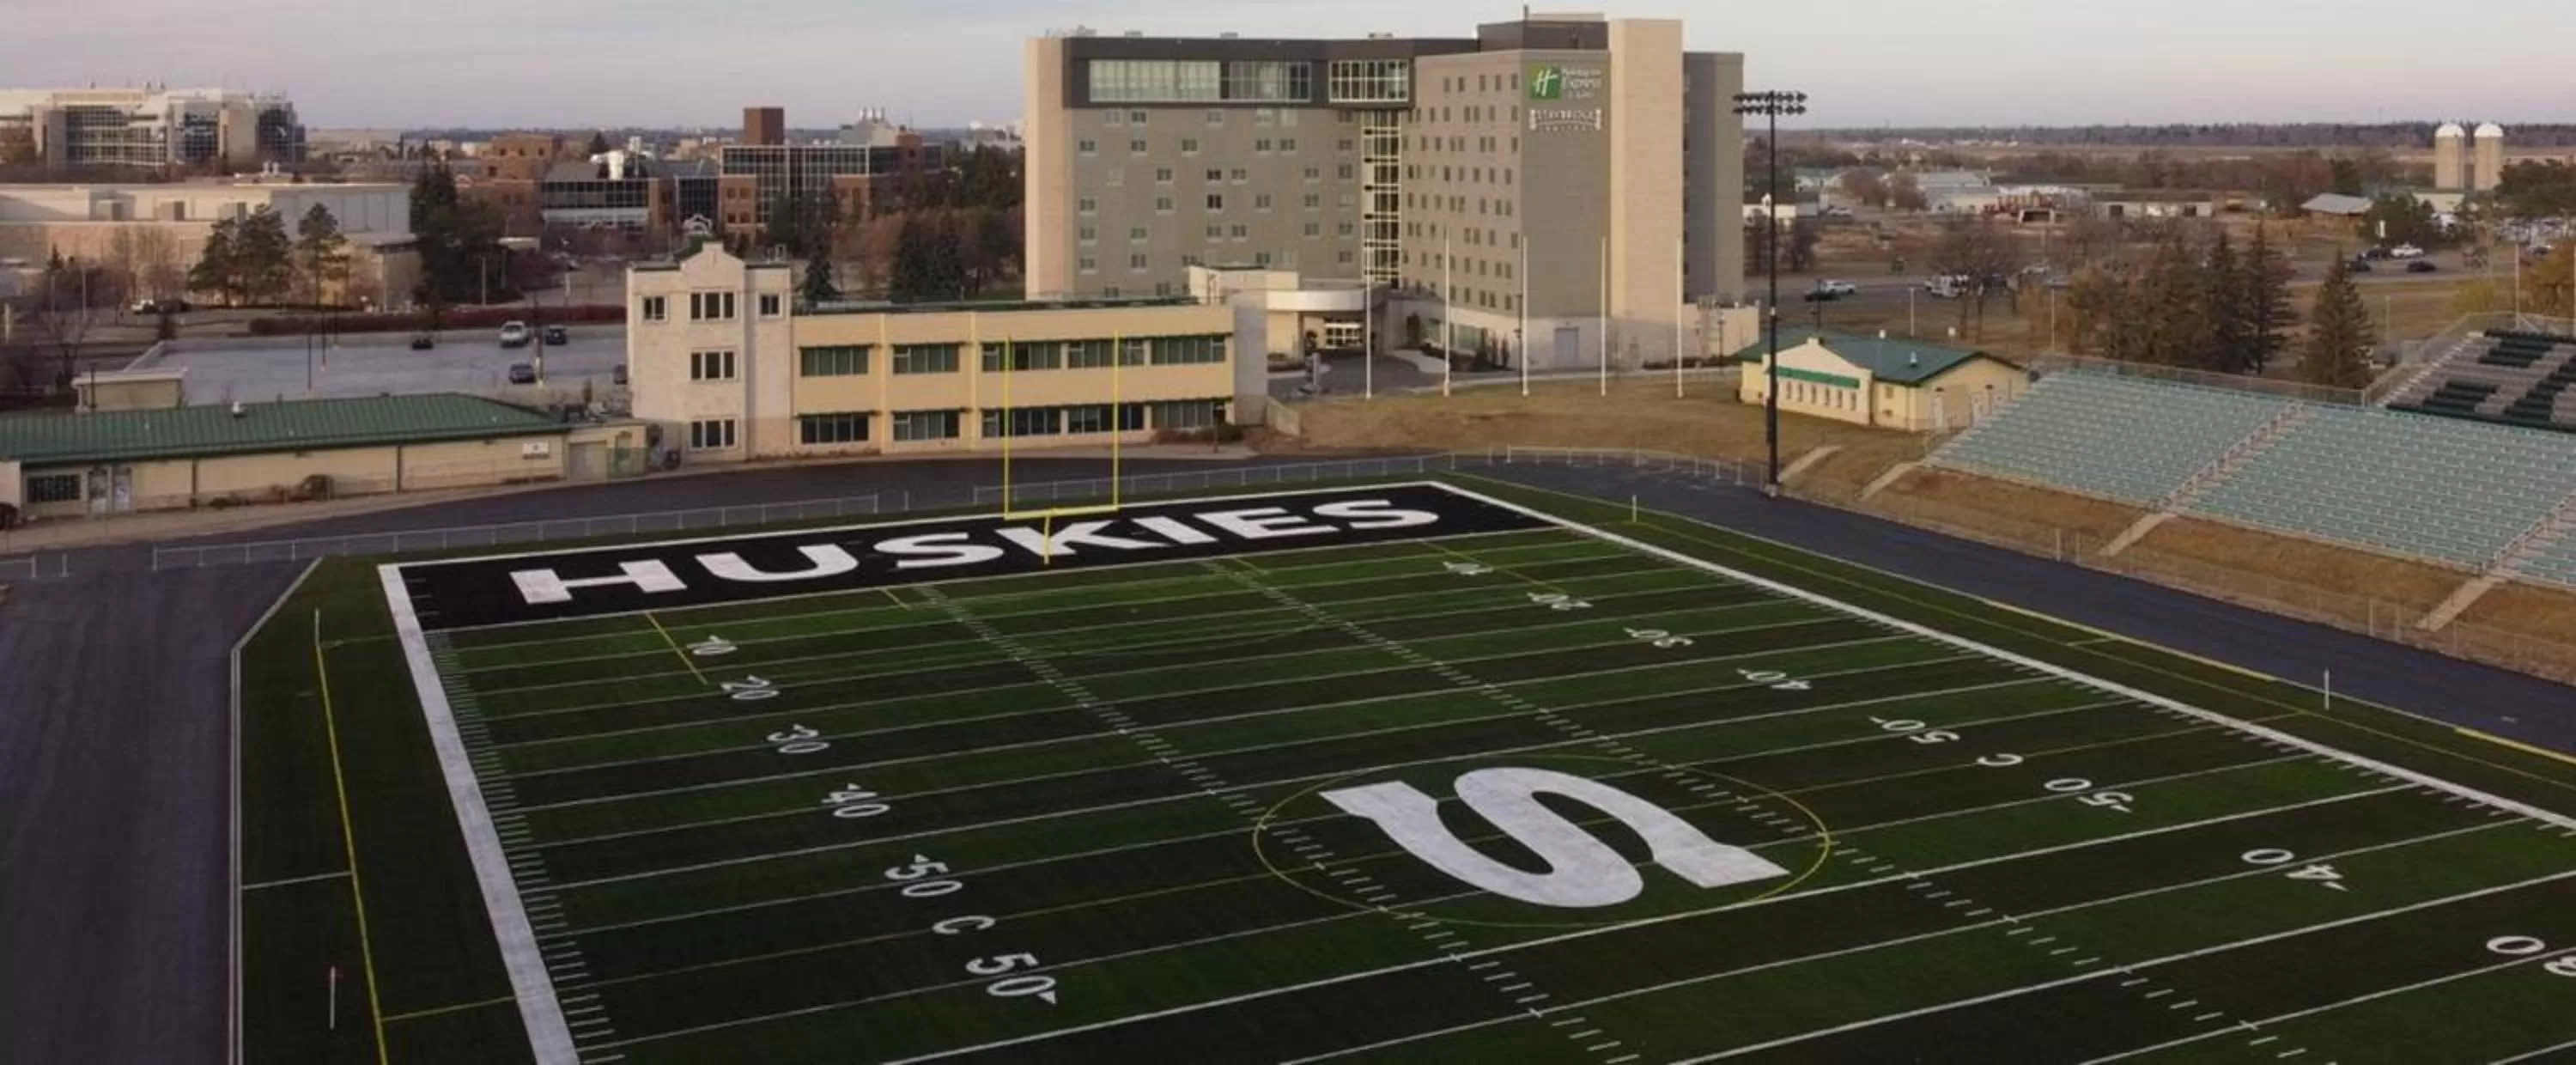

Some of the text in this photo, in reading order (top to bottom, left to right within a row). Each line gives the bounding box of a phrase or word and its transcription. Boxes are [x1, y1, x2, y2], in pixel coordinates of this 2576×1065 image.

[509, 499, 1440, 604] HUSKIES
[767, 726, 829, 753] 30
[822, 788, 891, 818] 40
[1318, 767, 1790, 908] S
[884, 860, 963, 898] 50
[2240, 849, 2343, 883] 40
[932, 916, 996, 934] C
[966, 952, 1056, 997] 50
